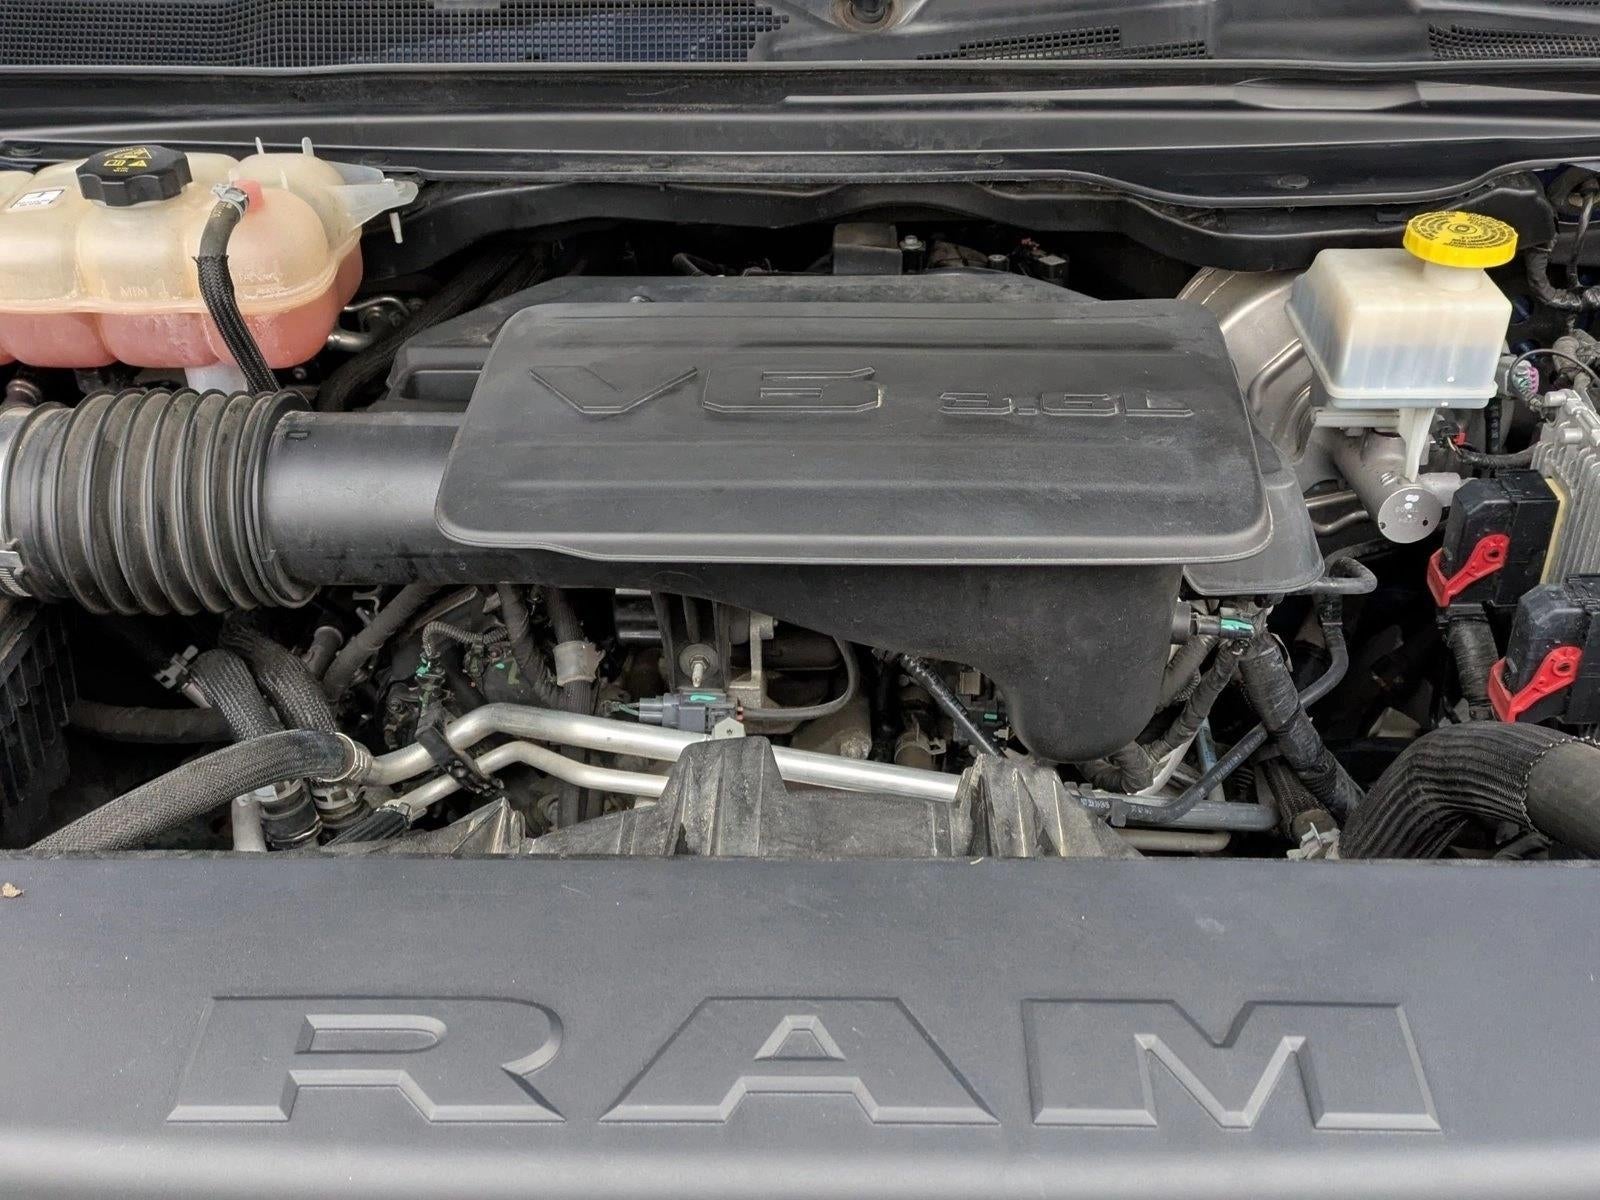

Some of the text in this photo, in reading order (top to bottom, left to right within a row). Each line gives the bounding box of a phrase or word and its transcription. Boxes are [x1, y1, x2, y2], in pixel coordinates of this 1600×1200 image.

[528, 364, 1194, 417] V6 3.6L
[166, 996, 1442, 1132] RAM
